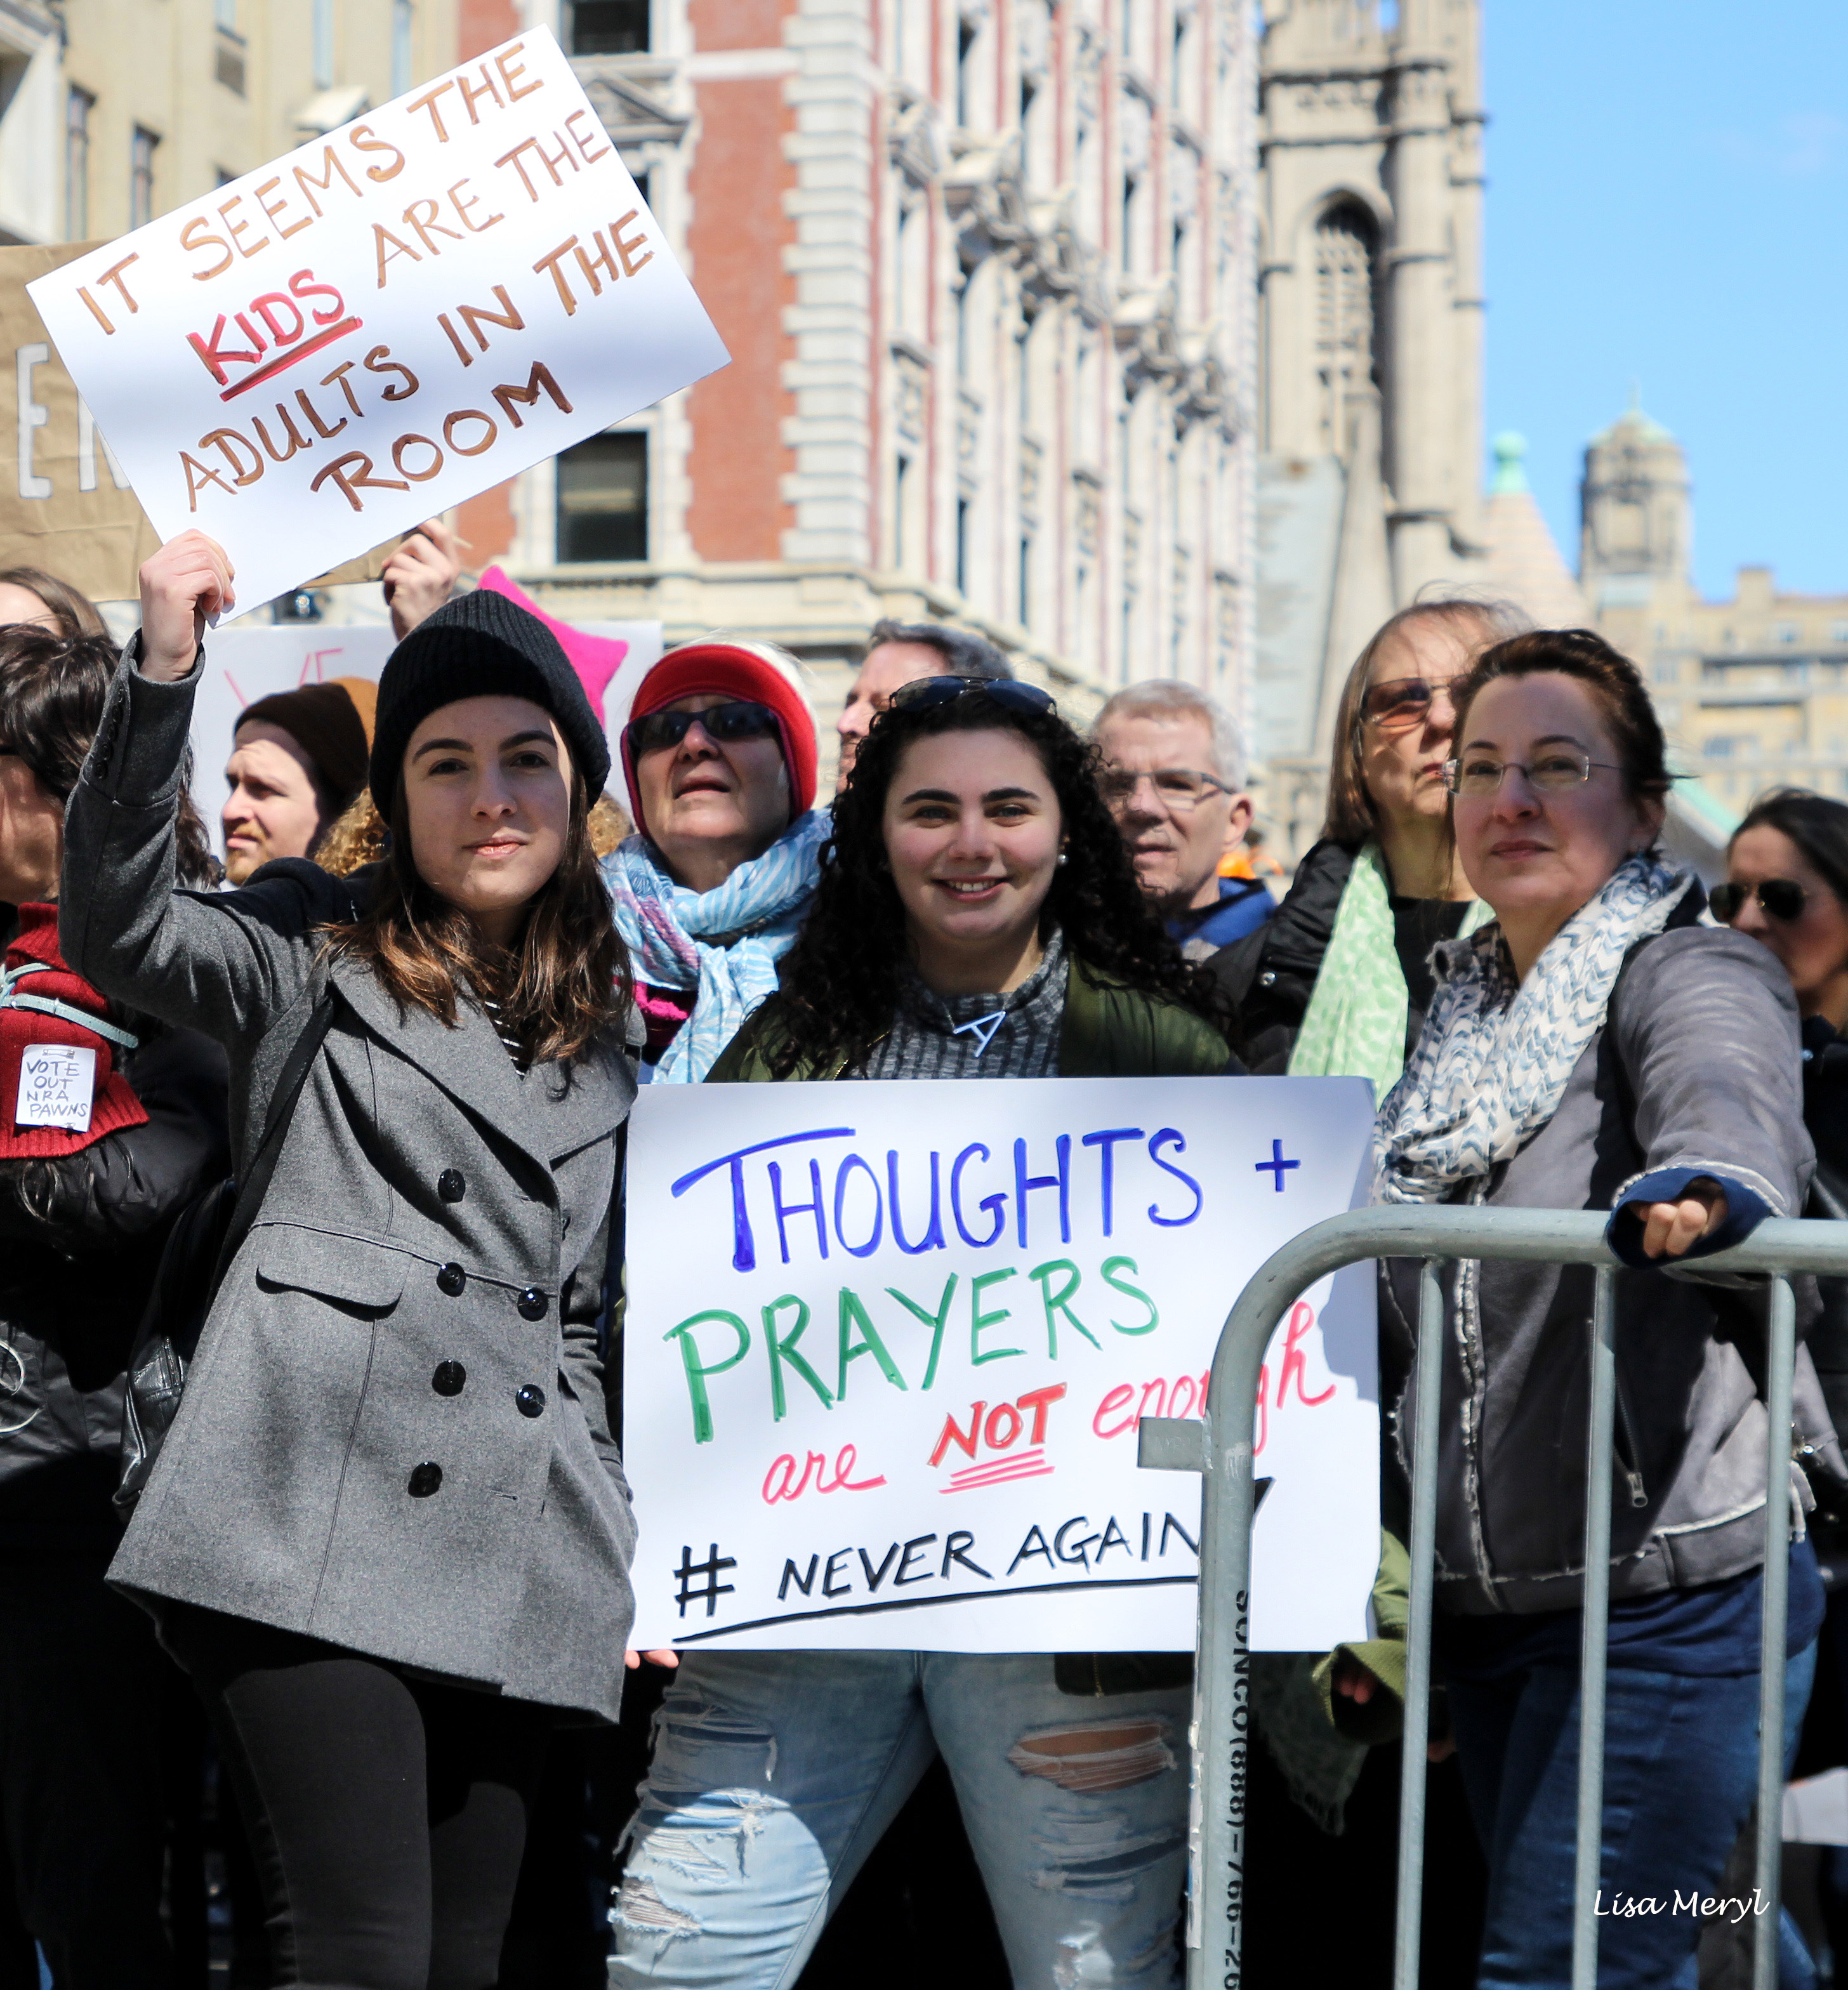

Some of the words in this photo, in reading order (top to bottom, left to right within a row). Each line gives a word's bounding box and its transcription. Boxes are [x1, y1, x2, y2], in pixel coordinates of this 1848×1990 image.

[76, 253, 140, 335] IT
[180, 124, 405, 280] SEEMS
[407, 42, 544, 143] THE
[186, 268, 346, 386] KIDS
[372, 178, 505, 289] ARE
[494, 109, 612, 202] THE
[178, 345, 419, 513] ADULTS
[437, 284, 526, 367] IN
[532, 209, 656, 316] THE
[310, 360, 574, 512] ROOM
[26, 1058, 80, 1077] VOTE
[26, 1090, 69, 1102] NRA
[30, 1102, 89, 1119] PAWNS
[34, 1075, 74, 1090] OUT
[670, 1126, 1205, 1274] THOUGHTS
[1254, 1138, 1302, 1194] +
[662, 1255, 1160, 1446] PRAYERS
[761, 1442, 888, 1506] are
[927, 1381, 1068, 1468] NOT
[673, 1543, 738, 1618] #
[777, 1529, 994, 1601] NEVER
